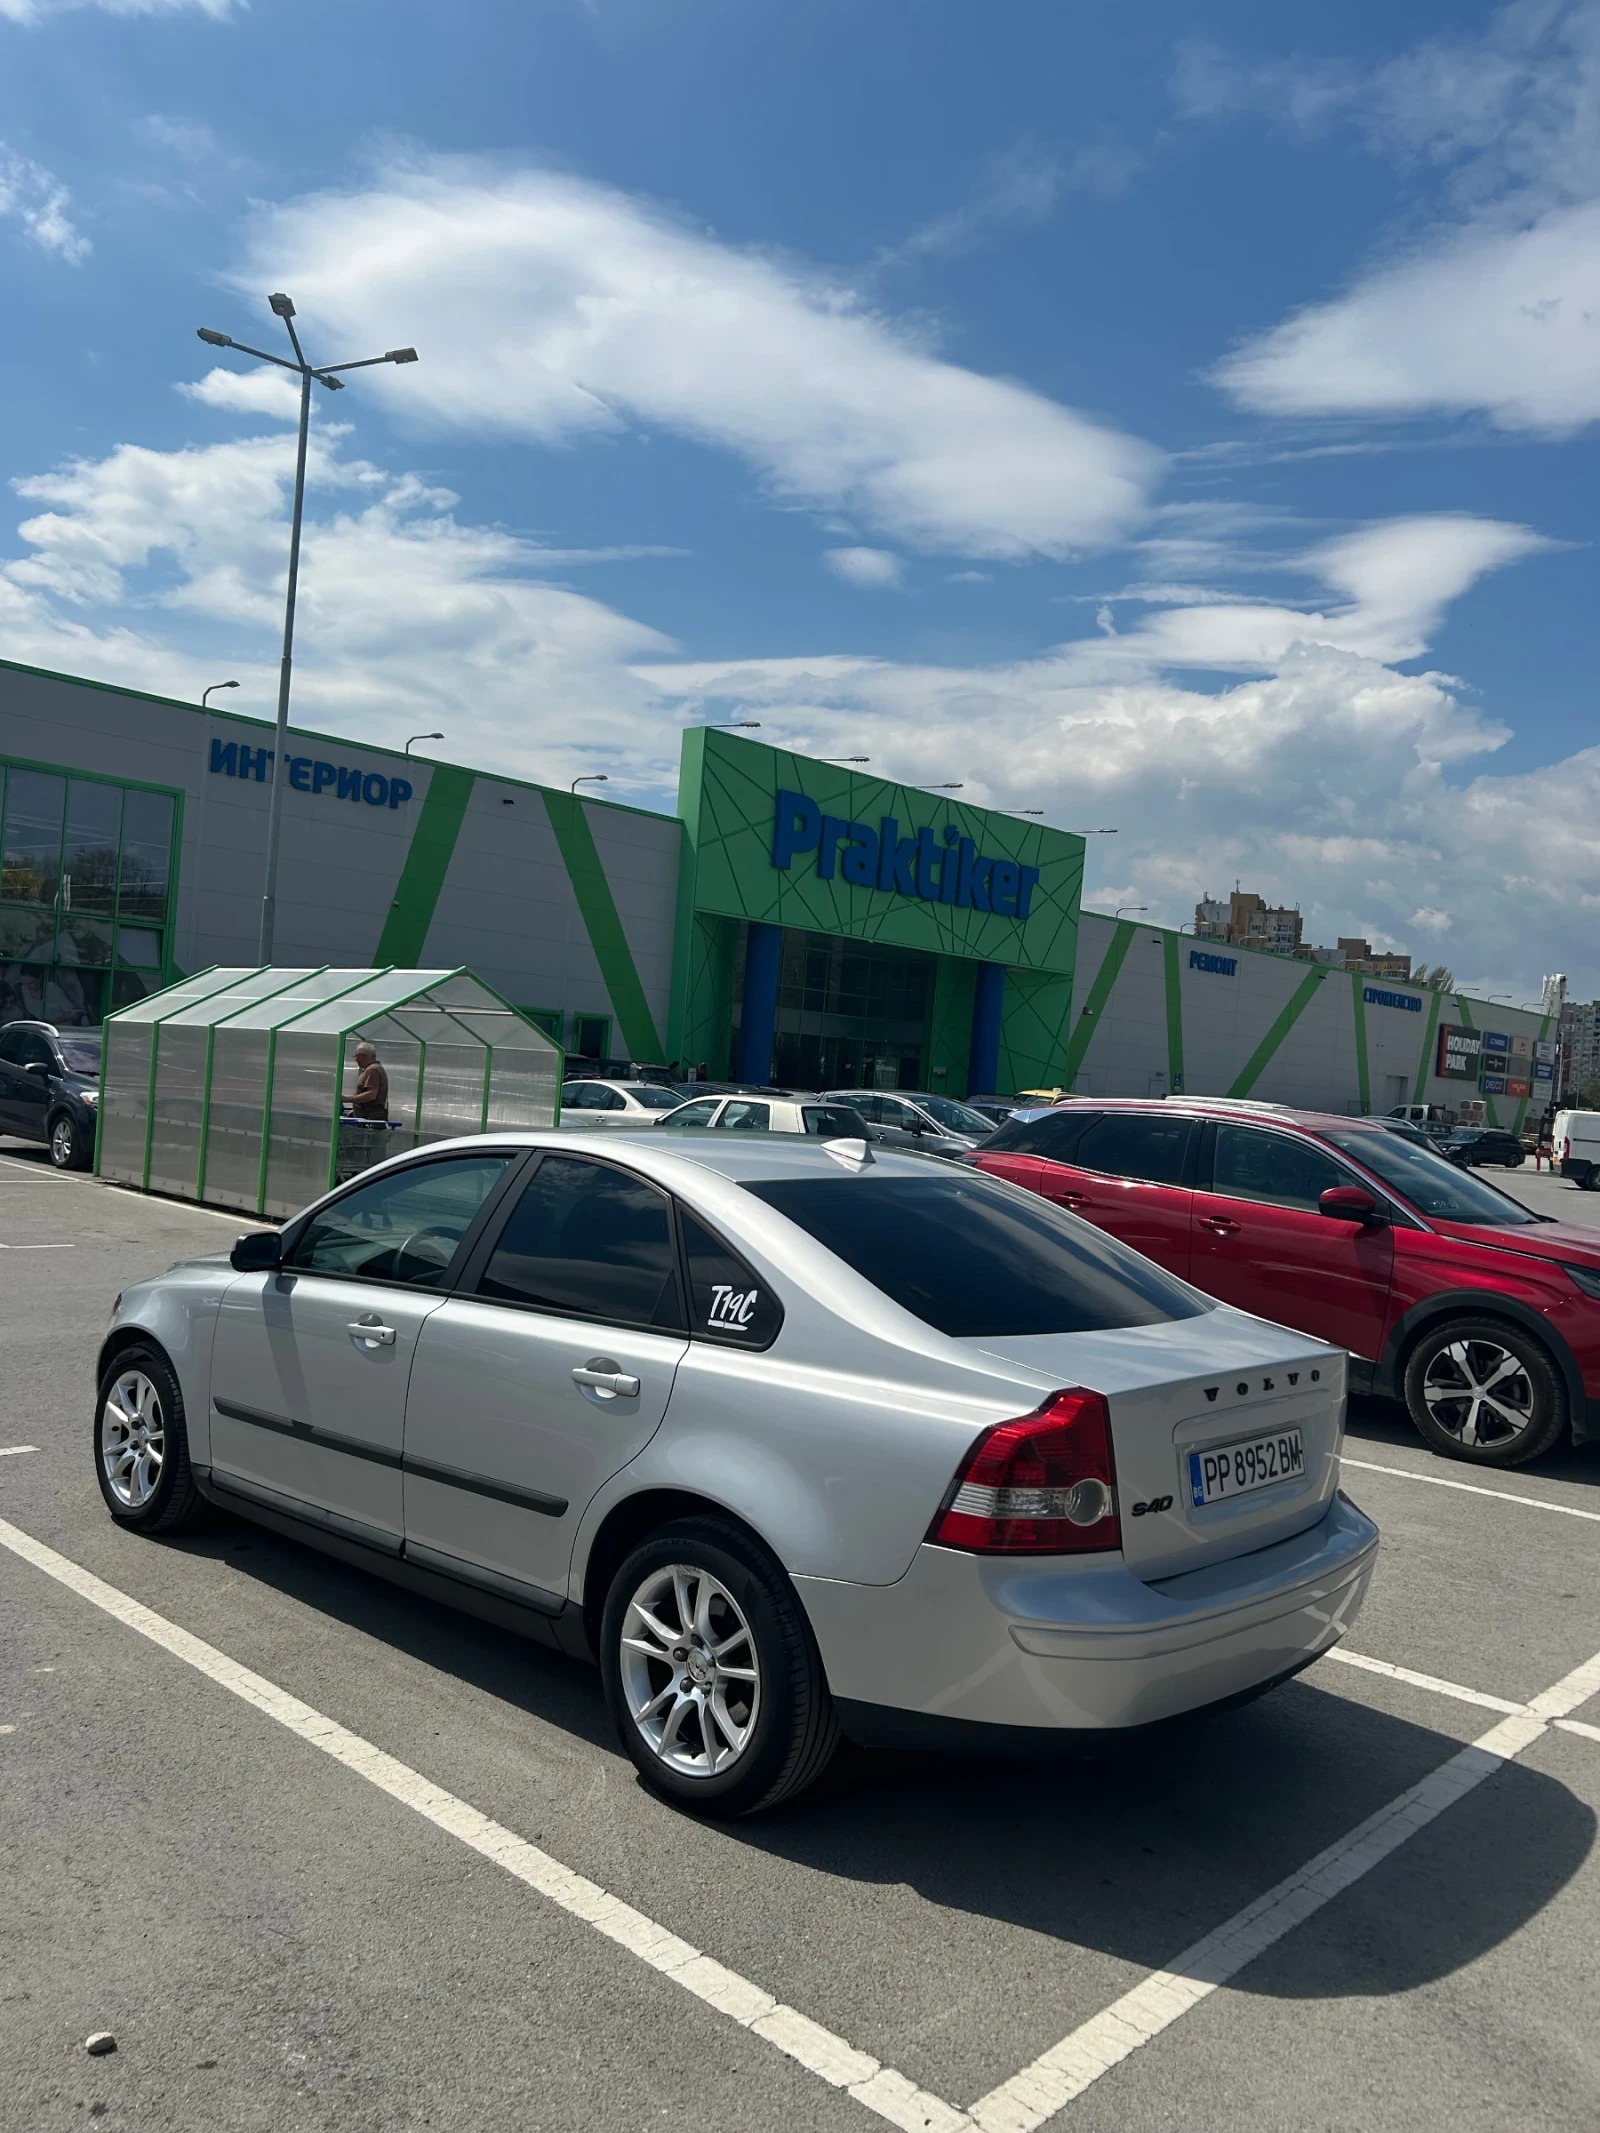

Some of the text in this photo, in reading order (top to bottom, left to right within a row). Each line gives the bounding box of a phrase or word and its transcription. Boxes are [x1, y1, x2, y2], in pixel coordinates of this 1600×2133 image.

[771, 788, 1040, 920] Praktiker
[1189, 950, 1238, 977] РЕМОНТ
[1447, 1034, 1480, 1055] HOLIDAY
[1445, 1053, 1467, 1071] PARK
[1204, 1369, 1320, 1402] VOLVO
[1193, 1485, 1204, 1498] BG
[1131, 1494, 1174, 1518] S40
